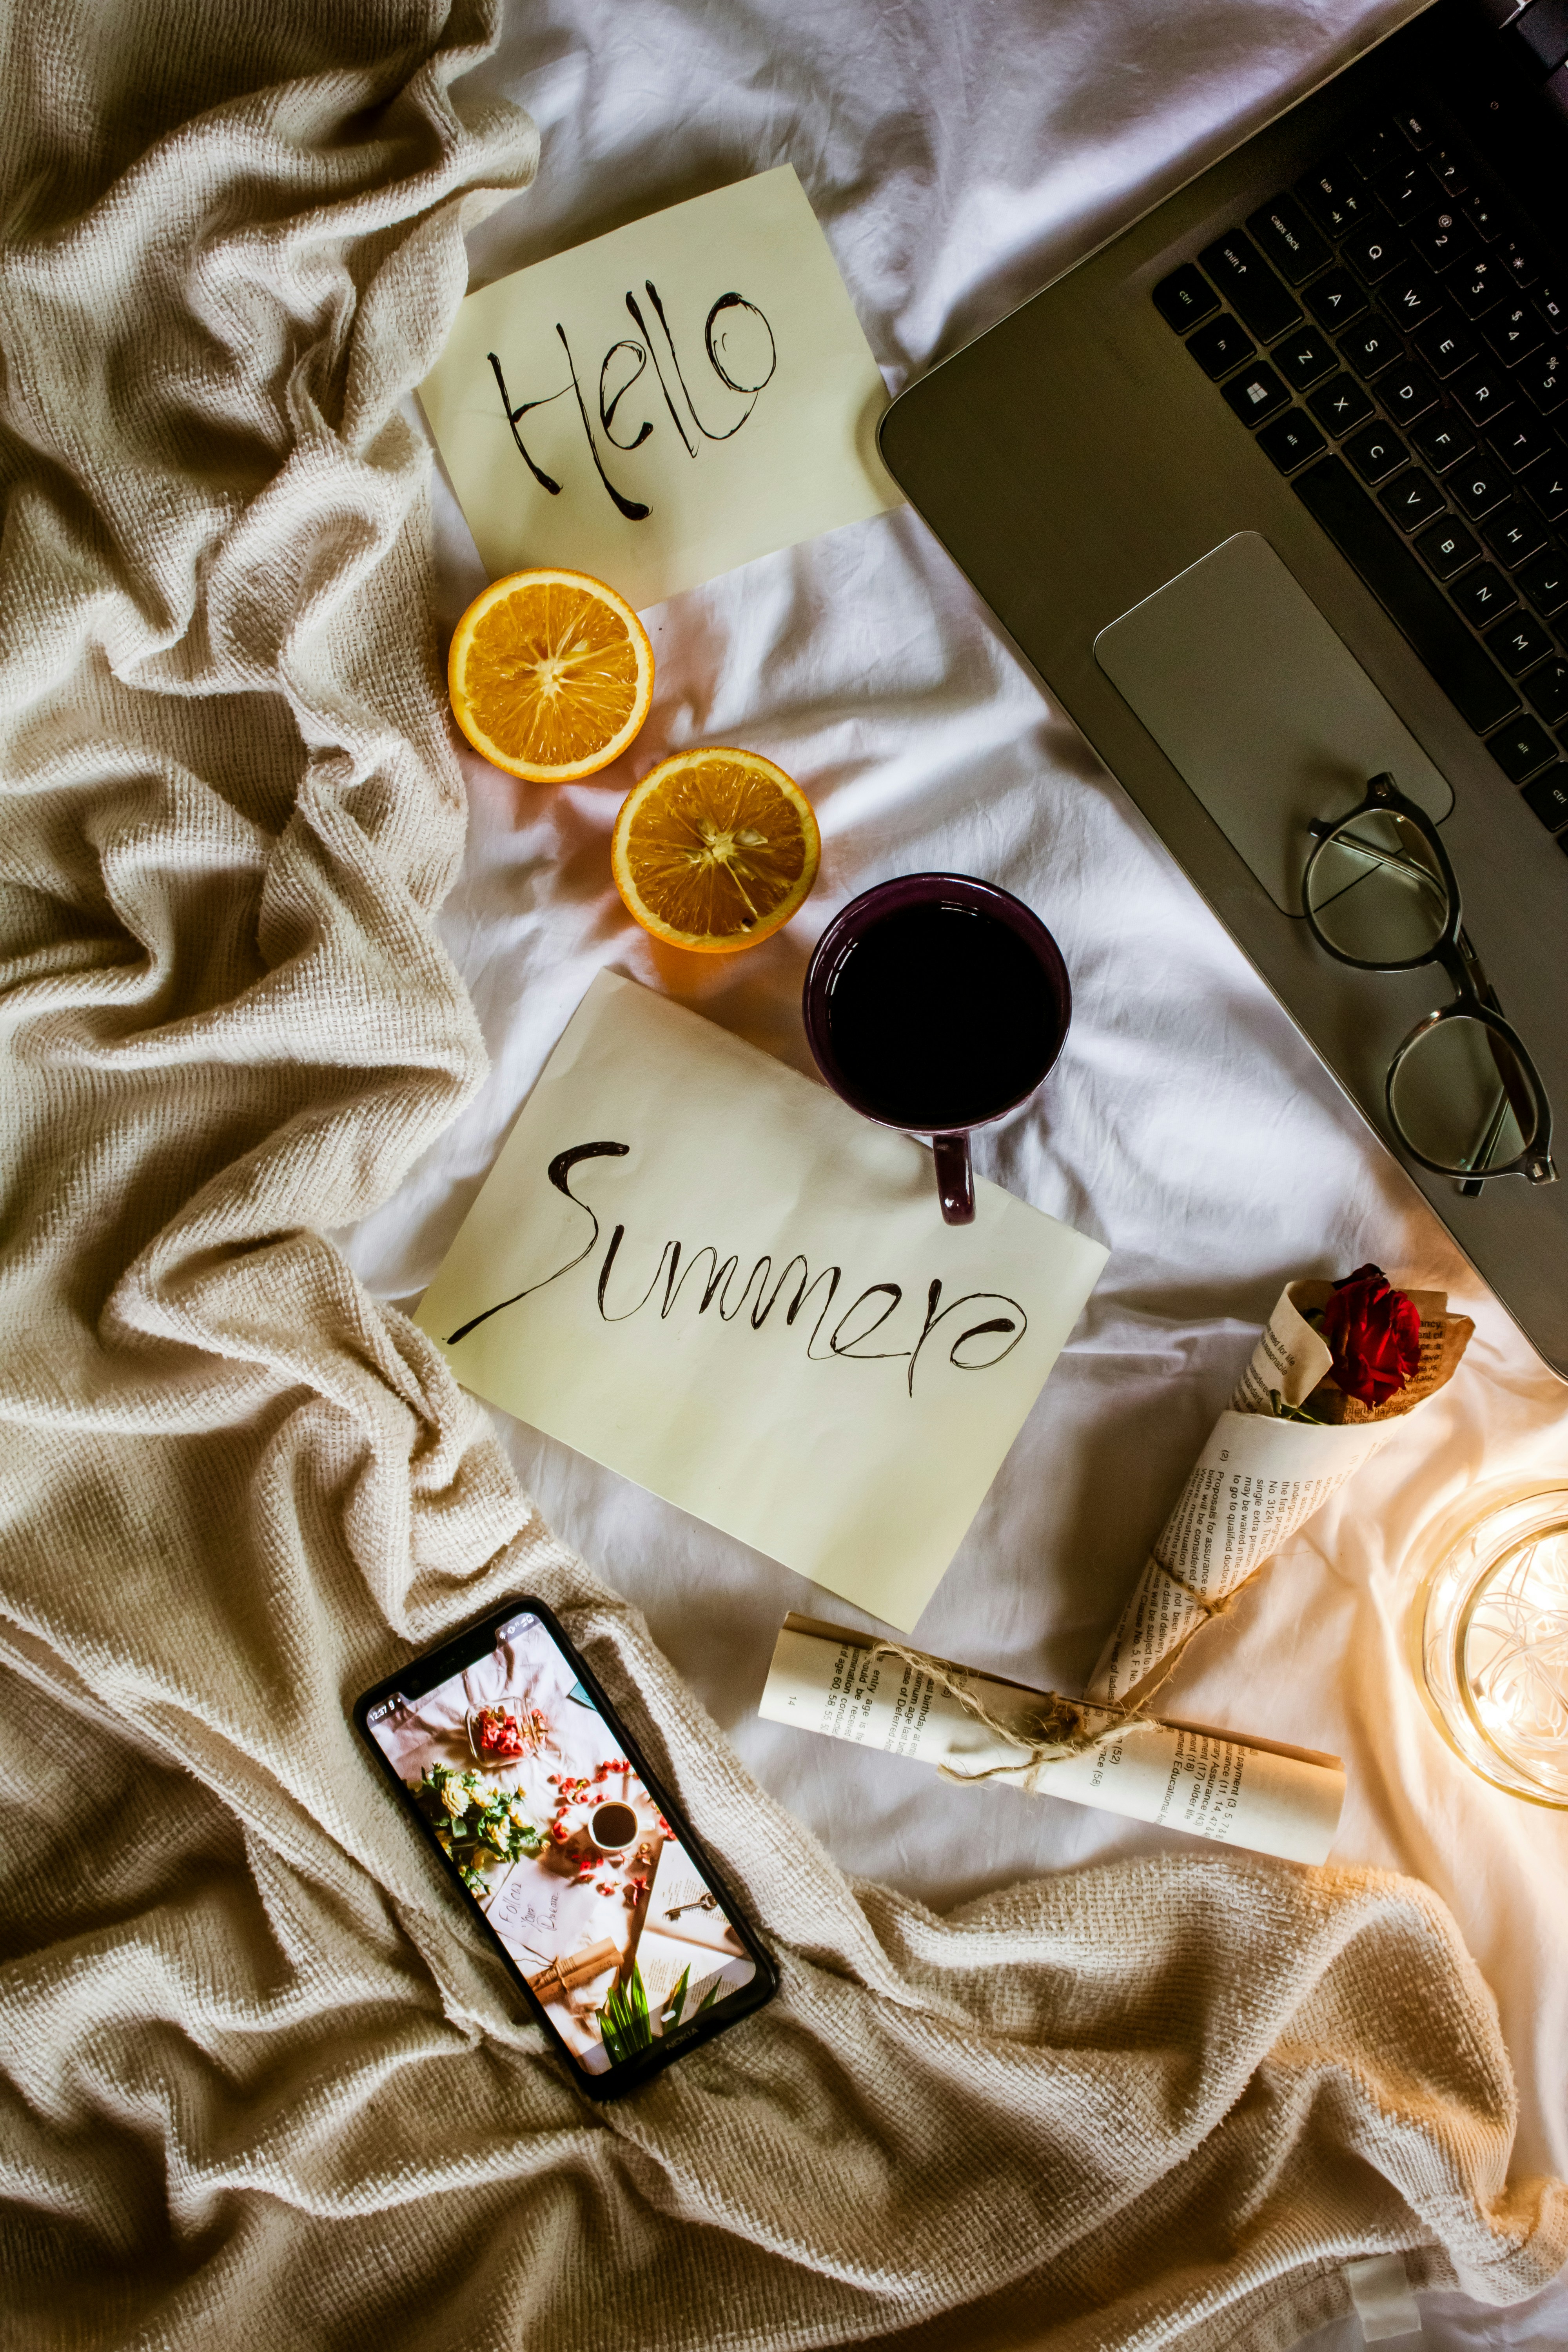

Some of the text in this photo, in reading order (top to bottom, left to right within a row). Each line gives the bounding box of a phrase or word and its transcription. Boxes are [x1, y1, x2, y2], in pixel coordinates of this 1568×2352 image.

[1320, 178, 1332, 193] tab
[1271, 216, 1299, 250] caps lock
[1435, 235, 1448, 247] 2
[1224, 249, 1239, 267] shift
[1369, 245, 1382, 260] Q
[1472, 282, 1484, 293] 3
[1179, 291, 1192, 304] ctrl
[1328, 294, 1341, 307] A
[1404, 289, 1421, 307] W
[1508, 332, 1519, 340] 4
[1218, 340, 1226, 350] fn
[1365, 340, 1378, 352] S
[1440, 339, 1454, 353] E
[1298, 350, 1313, 364] Z
[1543, 377, 1556, 388] 5
[487, 279, 776, 521] Hello
[1399, 385, 1413, 399] D
[1475, 387, 1489, 401] R
[1334, 397, 1348, 412] X
[1287, 435, 1298, 446] alt
[1436, 433, 1450, 443] F
[1514, 434, 1526, 445] T
[1370, 446, 1384, 458] C
[1473, 482, 1486, 495] G
[1550, 481, 1563, 493] Y
[1407, 492, 1421, 504] V
[1507, 528, 1523, 543] H
[1441, 539, 1455, 553] B
[1476, 587, 1492, 602] N
[1512, 635, 1528, 650] M
[1518, 743, 1528, 753] alt
[1553, 790, 1567, 804] ctrl
[1262, 1342, 1289, 1376] reasonable
[1277, 1344, 1289, 1356] for
[1284, 1353, 1297, 1367] life
[1232, 1474, 1241, 1484] to
[1241, 1476, 1252, 1497] may
[1303, 1479, 1314, 1492] for
[1229, 1486, 1239, 1499] go
[1253, 1479, 1265, 1507] single
[1267, 1480, 1278, 1497] No.
[1307, 1478, 1323, 1511] accepted
[1316, 1475, 1333, 1508] expected
[1182, 1489, 1194, 1513] three
[1229, 1501, 1238, 1511] to
[1241, 1500, 1250, 1512] be
[1285, 1480, 1301, 1524] undergone
[1262, 1499, 1275, 1526] 3124).
[1265, 1480, 1290, 1553] the first pregnancy
[1200, 1449, 1229, 1597] (2) Proposals for assurance on
[1252, 1510, 1261, 1532] extra
[1172, 1514, 1185, 1549] months
[1224, 1513, 1237, 1552] qualified
[1238, 1514, 1249, 1545] waived
[1260, 1527, 1271, 1545] This
[1161, 1536, 1171, 1558] such
[1171, 1468, 1207, 1633] Where menstruation not been
[1183, 1469, 1215, 1626] birth will be considered three
[1243, 1535, 1257, 1568] premium
[1220, 1554, 1232, 1584] doctors
[1234, 1555, 1243, 1569] the
[1149, 1591, 1160, 1607] will
[1161, 1590, 1172, 1611] date
[1147, 1609, 1157, 1622] be
[1160, 1612, 1169, 1621] of
[1116, 1624, 1126, 1639] the
[1129, 1594, 1148, 1684] Clause No. 5, F. No.
[1142, 1624, 1156, 1655] subject
[1154, 1622, 1169, 1656] delivery,
[1111, 1641, 1122, 1663] lives
[833, 1657, 845, 1675] age
[1110, 1664, 1119, 1674] of
[1143, 1657, 1152, 1665] to
[829, 1676, 842, 1691] 60,
[866, 1669, 880, 1694] entry
[902, 1667, 913, 1684] case
[831, 1648, 861, 1735] examination conducted
[899, 1687, 909, 1698] of
[1107, 1675, 1118, 1700] ladies
[787, 1695, 797, 1706] 14
[824, 1694, 837, 1708] 58,
[860, 1698, 873, 1717] age
[367, 1703, 389, 1722] 12:37
[821, 1710, 833, 1722] 55,
[844, 1688, 864, 1737] be received
[888, 1698, 906, 1737] Deferred
[903, 1706, 915, 1724] age
[913, 1694, 933, 1732] birthday
[855, 1732, 865, 1741] the
[900, 1726, 911, 1741] last
[911, 1733, 922, 1742] at
[1108, 1746, 1123, 1765] (52)
[1183, 1754, 1196, 1772] (18)
[1089, 1770, 1104, 1787] (58)
[1230, 1756, 1243, 1795] payment
[1160, 1760, 1183, 1813] Educational
[1184, 1762, 1207, 1820] (17) older life
[1192, 1761, 1220, 1827] Assurance (43)
[1216, 1779, 1229, 1797] (11,
[1210, 1800, 1223, 1813] 14,
[1225, 1798, 1237, 1810] (3,
[1208, 1816, 1218, 1826] 47
[664, 2025, 700, 2051] NOKIA
